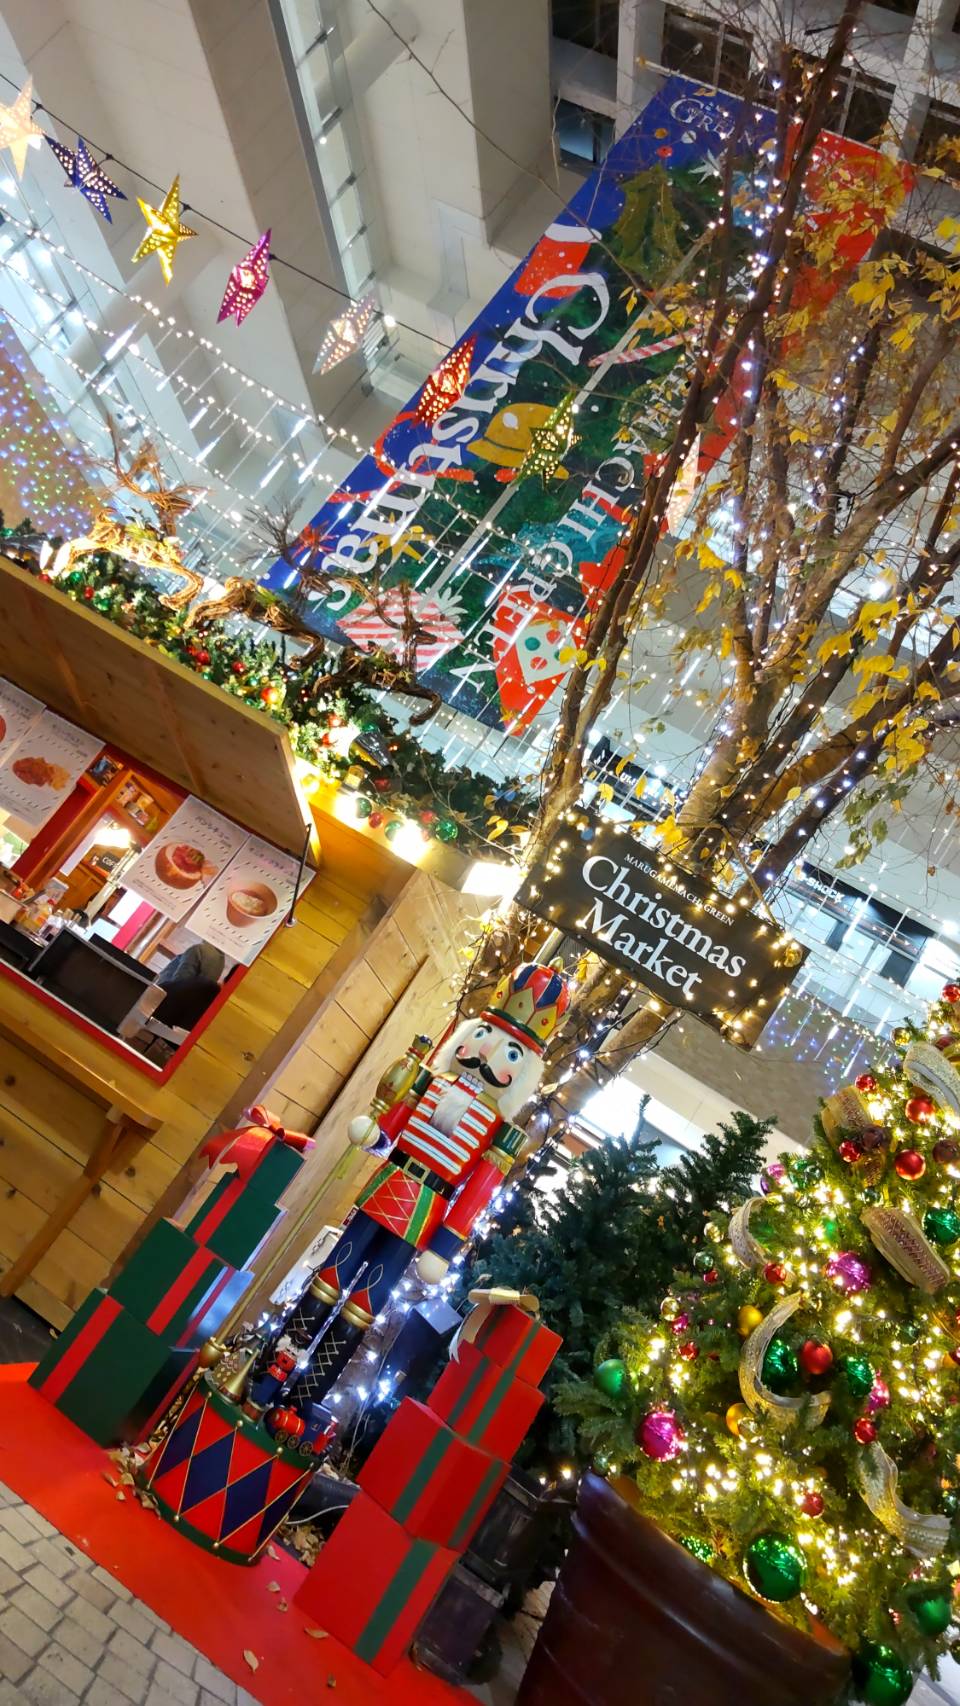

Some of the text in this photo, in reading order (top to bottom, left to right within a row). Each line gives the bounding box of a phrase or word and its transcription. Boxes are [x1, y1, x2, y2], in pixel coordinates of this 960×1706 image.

[306, 271, 610, 612] Christmas
[449, 540, 574, 694] GREEN
[579, 897, 703, 1000] Market
[582, 855, 747, 977] Christmas
[703, 902, 736, 927] GREEN
